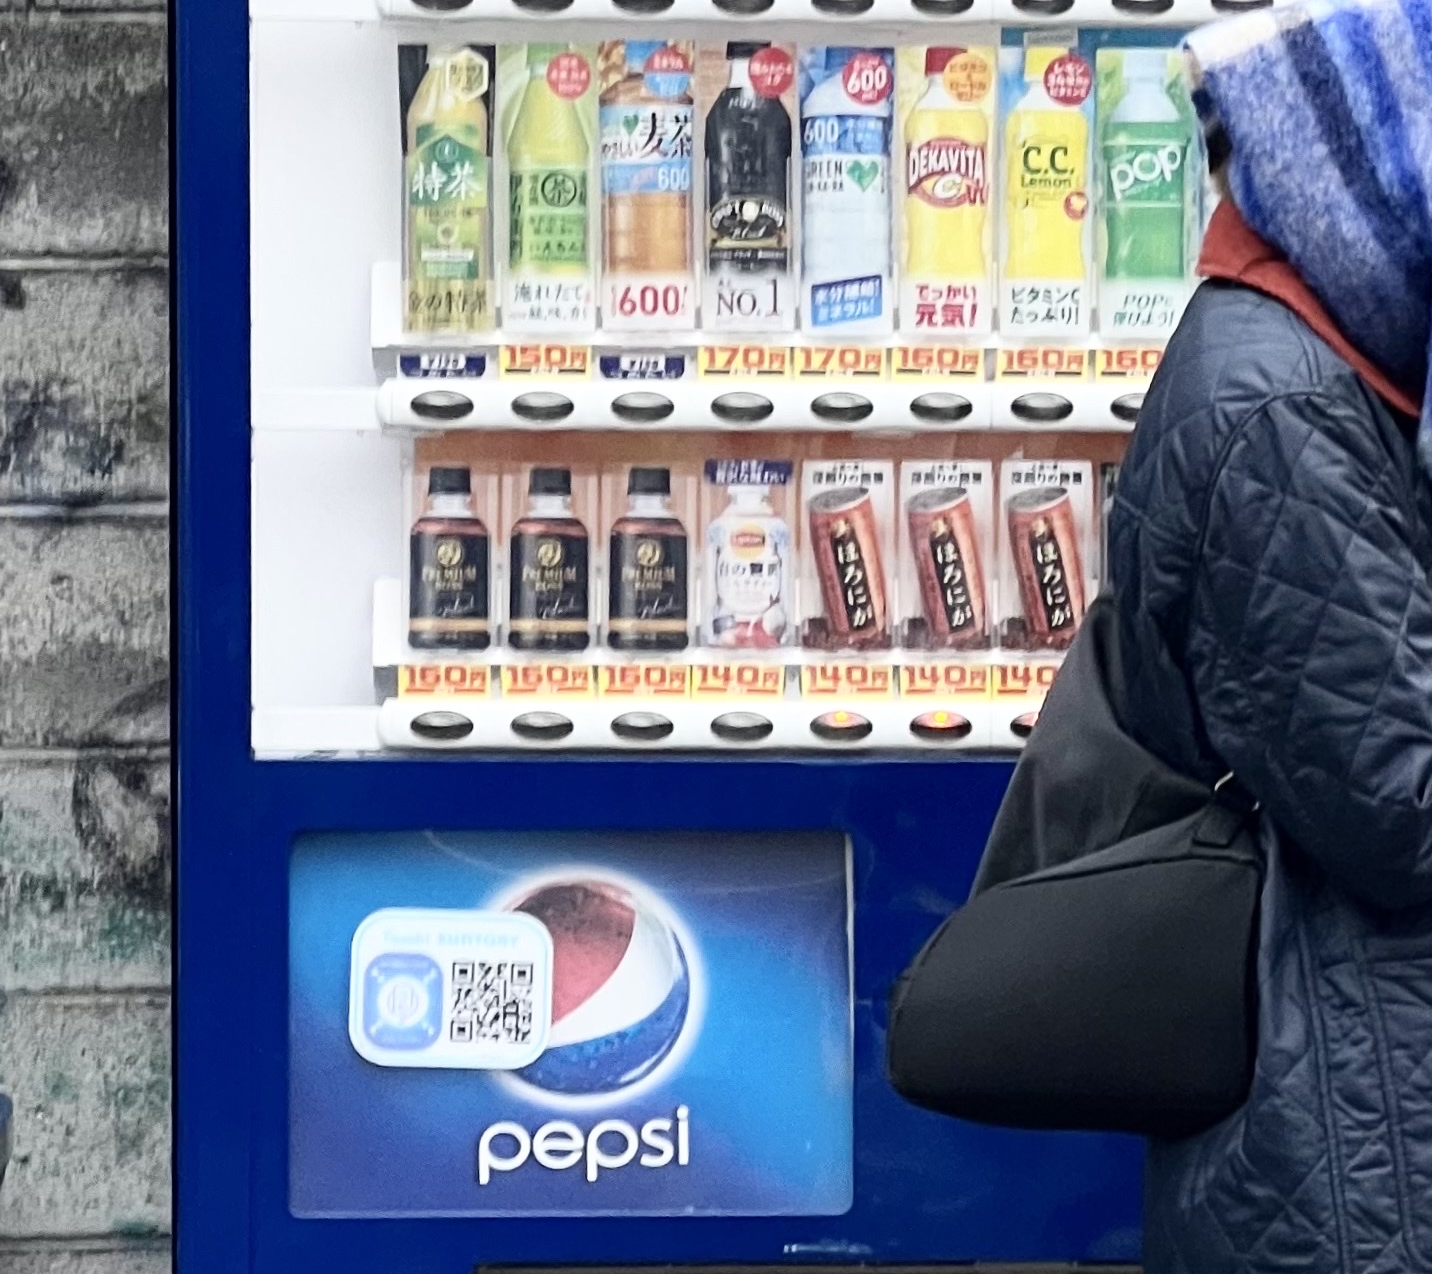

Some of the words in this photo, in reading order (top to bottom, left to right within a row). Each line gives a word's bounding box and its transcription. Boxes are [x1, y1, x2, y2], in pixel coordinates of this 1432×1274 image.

[846, 64, 888, 95] 600
[639, 110, 693, 159] 麦茶
[803, 118, 839, 145] 600
[908, 146, 984, 189] DEKAVITA
[1022, 144, 1076, 176] C.C.
[410, 159, 483, 203] 特茶
[657, 166, 691, 192] 600
[1020, 175, 1072, 189] Lemon
[1011, 286, 1081, 306] ビタミンC
[505, 344, 588, 369] 150円
[704, 347, 787, 371] 170円
[802, 347, 882, 370] 170円
[900, 347, 979, 370] 160円
[1002, 348, 1084, 372] 160円
[836, 541, 874, 629] ほろにが
[935, 541, 974, 628] ほろにが
[1035, 541, 1072, 628] ほろにが
[697, 664, 779, 689] 140円
[806, 664, 889, 689] 140円
[904, 665, 987, 689] 140円
[476, 1103, 691, 1186] pepsi
